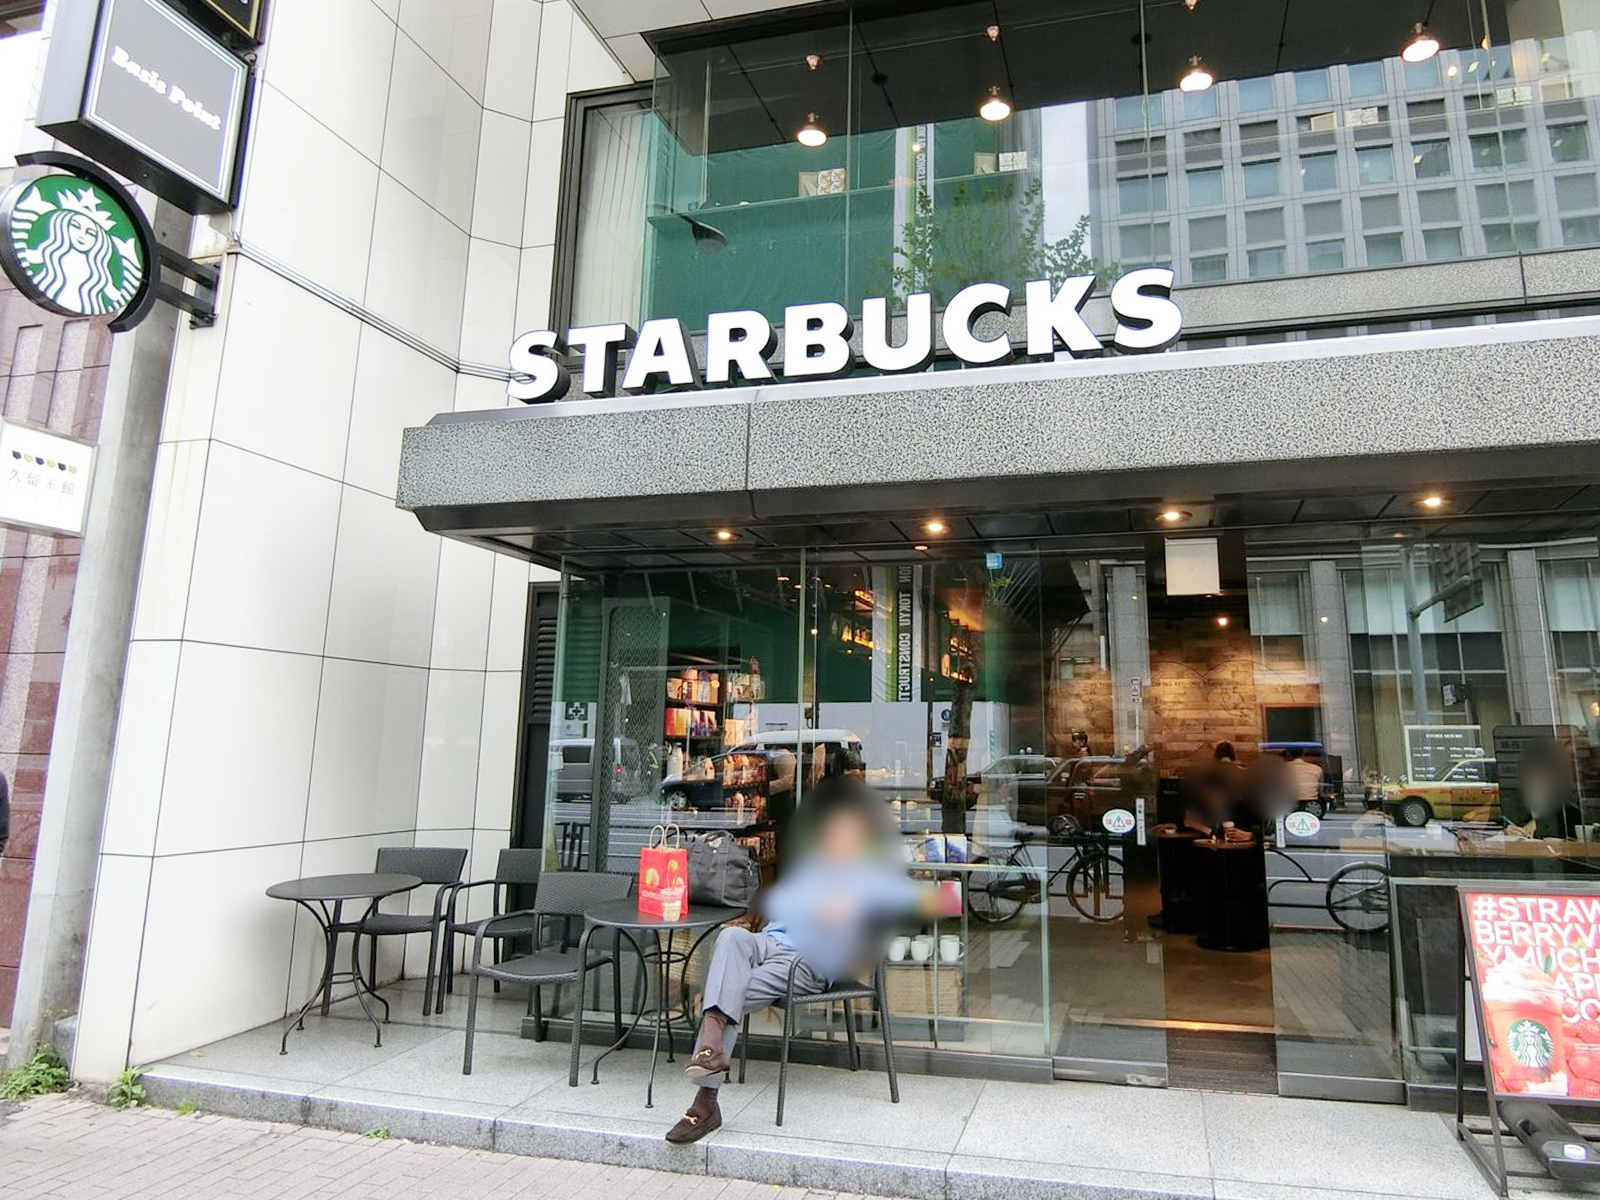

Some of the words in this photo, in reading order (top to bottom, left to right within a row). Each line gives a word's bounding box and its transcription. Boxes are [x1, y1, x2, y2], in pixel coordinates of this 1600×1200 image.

[111, 45, 168, 95] Basis
[168, 84, 222, 131] Point
[506, 266, 1183, 401] STARBUCKS
[1474, 919, 1600, 949] BERRYV
